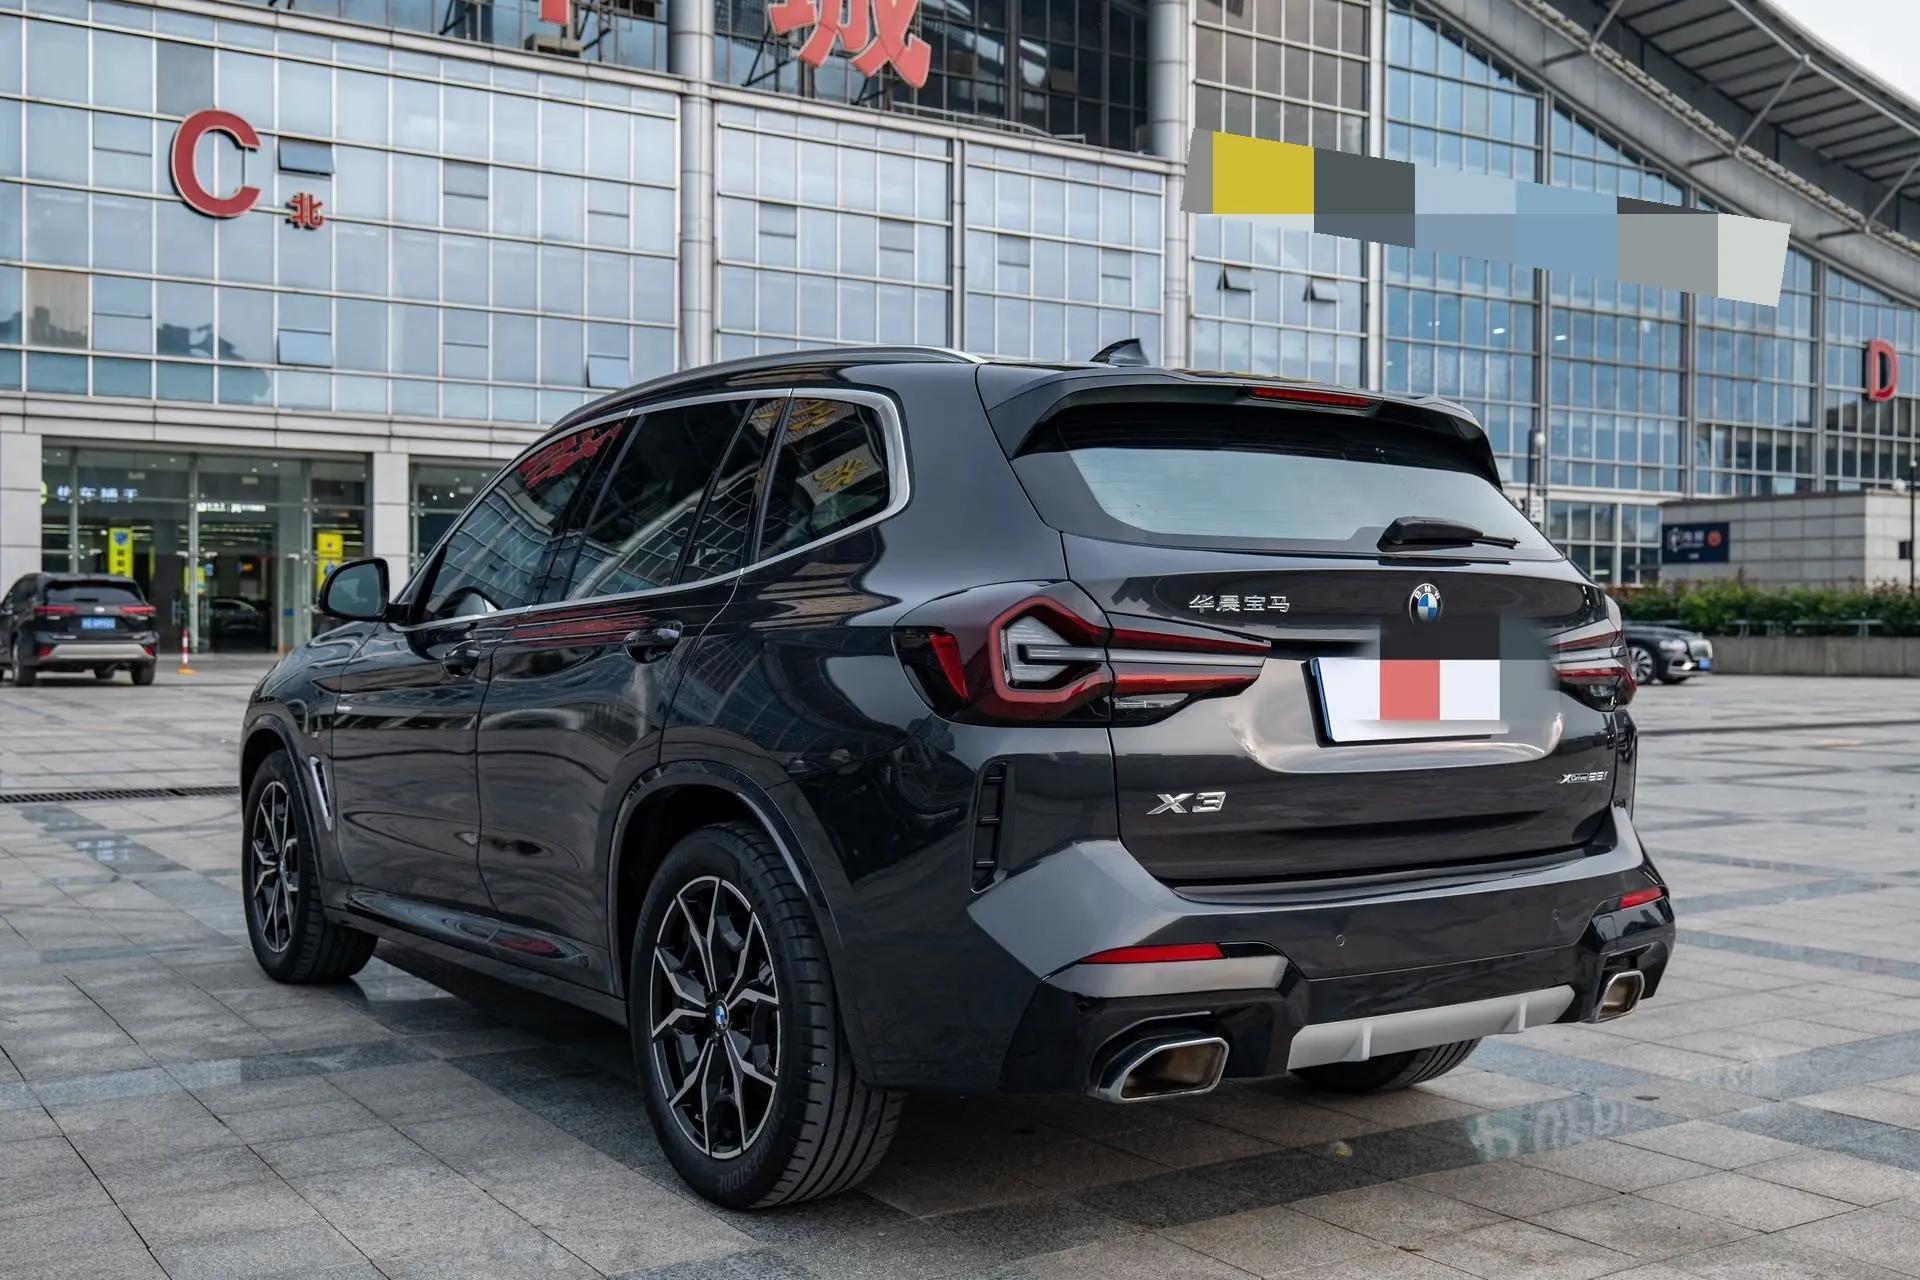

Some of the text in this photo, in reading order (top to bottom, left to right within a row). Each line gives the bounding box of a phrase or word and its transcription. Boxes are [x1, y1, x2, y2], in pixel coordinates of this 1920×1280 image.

[171, 109, 261, 218] C
[288, 191, 325, 229] 北
[1868, 339, 1899, 401] D
[1188, 594, 1291, 614] 华晨宝马
[1145, 791, 1227, 815] X3
